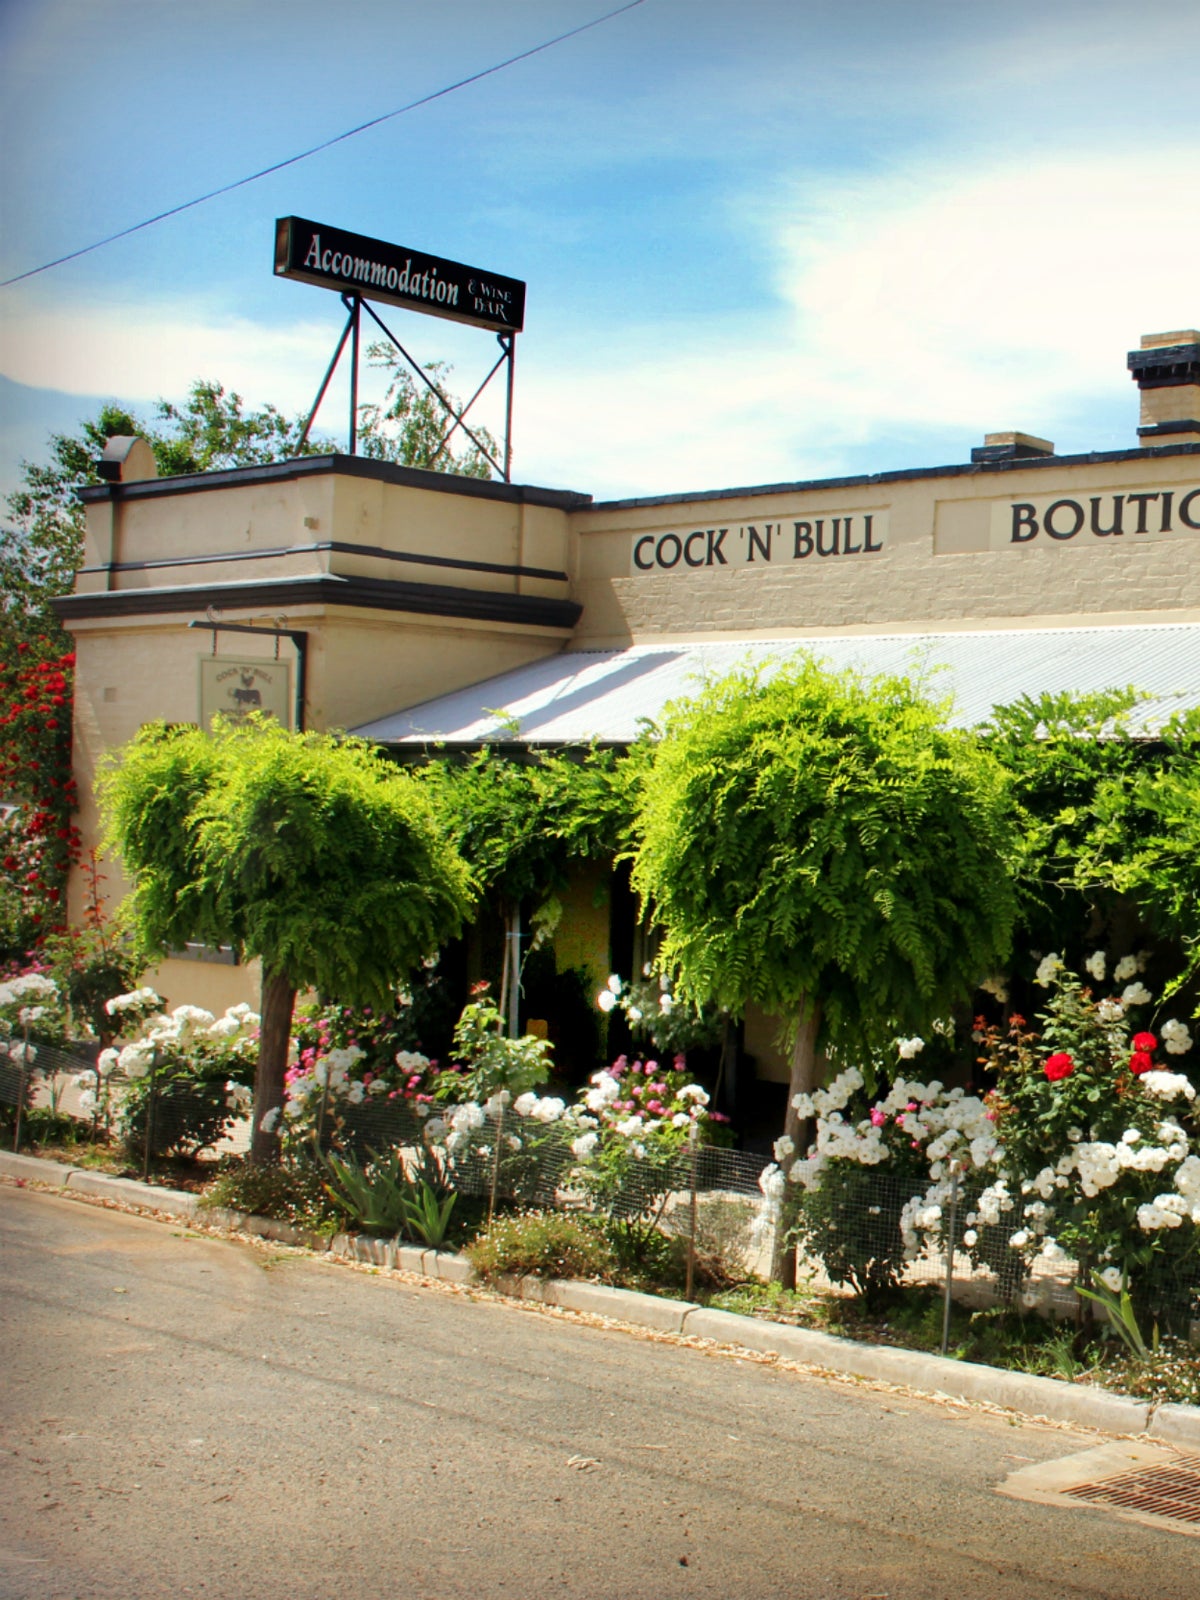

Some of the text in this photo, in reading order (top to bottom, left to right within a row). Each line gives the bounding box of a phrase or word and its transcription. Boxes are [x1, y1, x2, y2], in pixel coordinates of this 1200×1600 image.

[304, 233, 459, 306] Accommodation
[480, 282, 512, 304] WINE
[474, 296, 509, 322] BAR
[633, 514, 884, 571] COCK 'N' BULL
[215, 667, 239, 683] COCK
[253, 668, 273, 684] BULL
